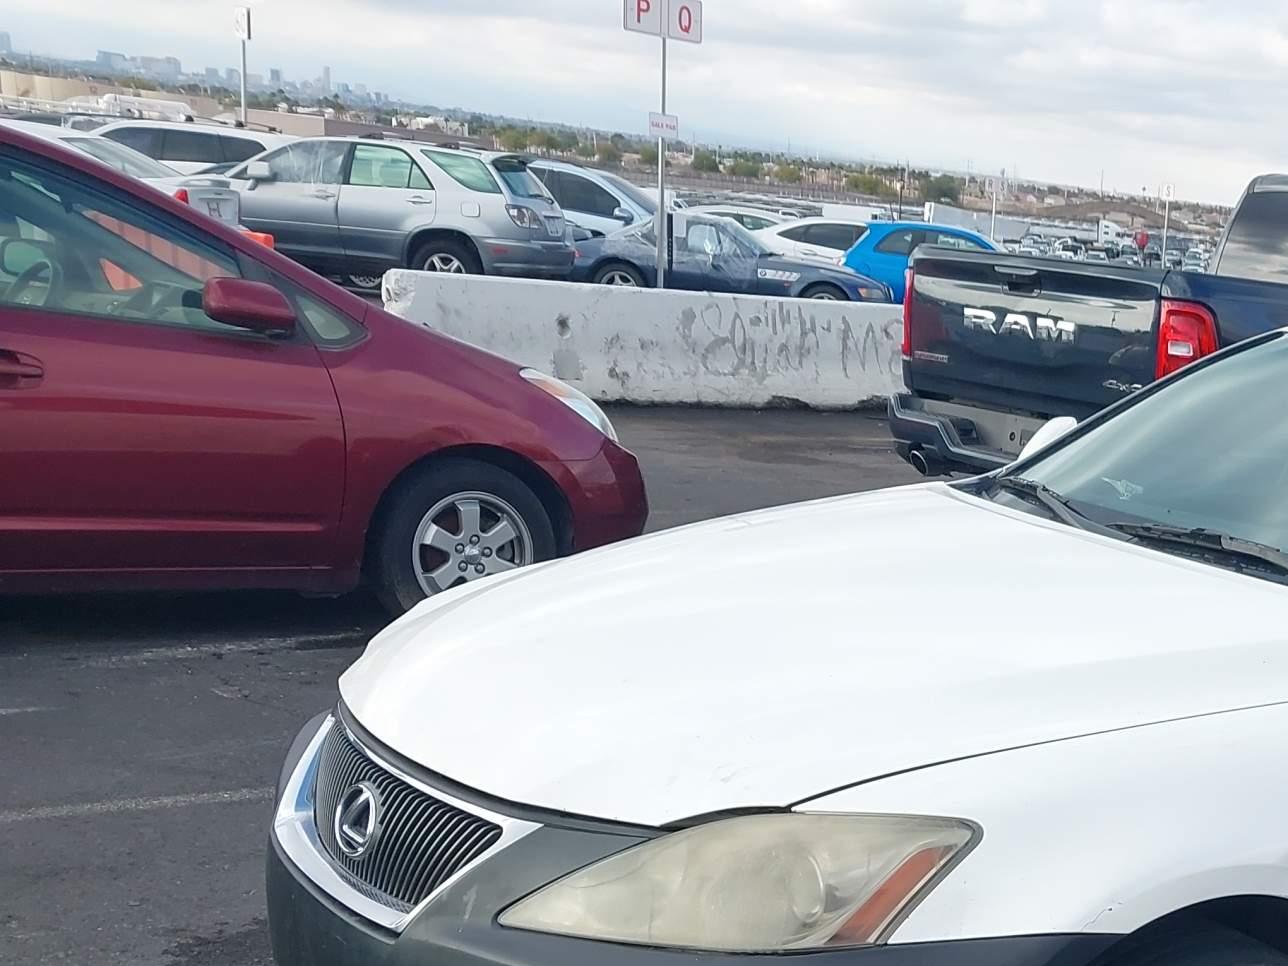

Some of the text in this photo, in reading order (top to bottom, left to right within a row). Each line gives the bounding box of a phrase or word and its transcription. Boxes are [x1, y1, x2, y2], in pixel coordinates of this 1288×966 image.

[637, 0, 650, 24] P
[678, 5, 692, 33] Q
[1165, 185, 1171, 197] S
[963, 307, 1076, 345] RAM
